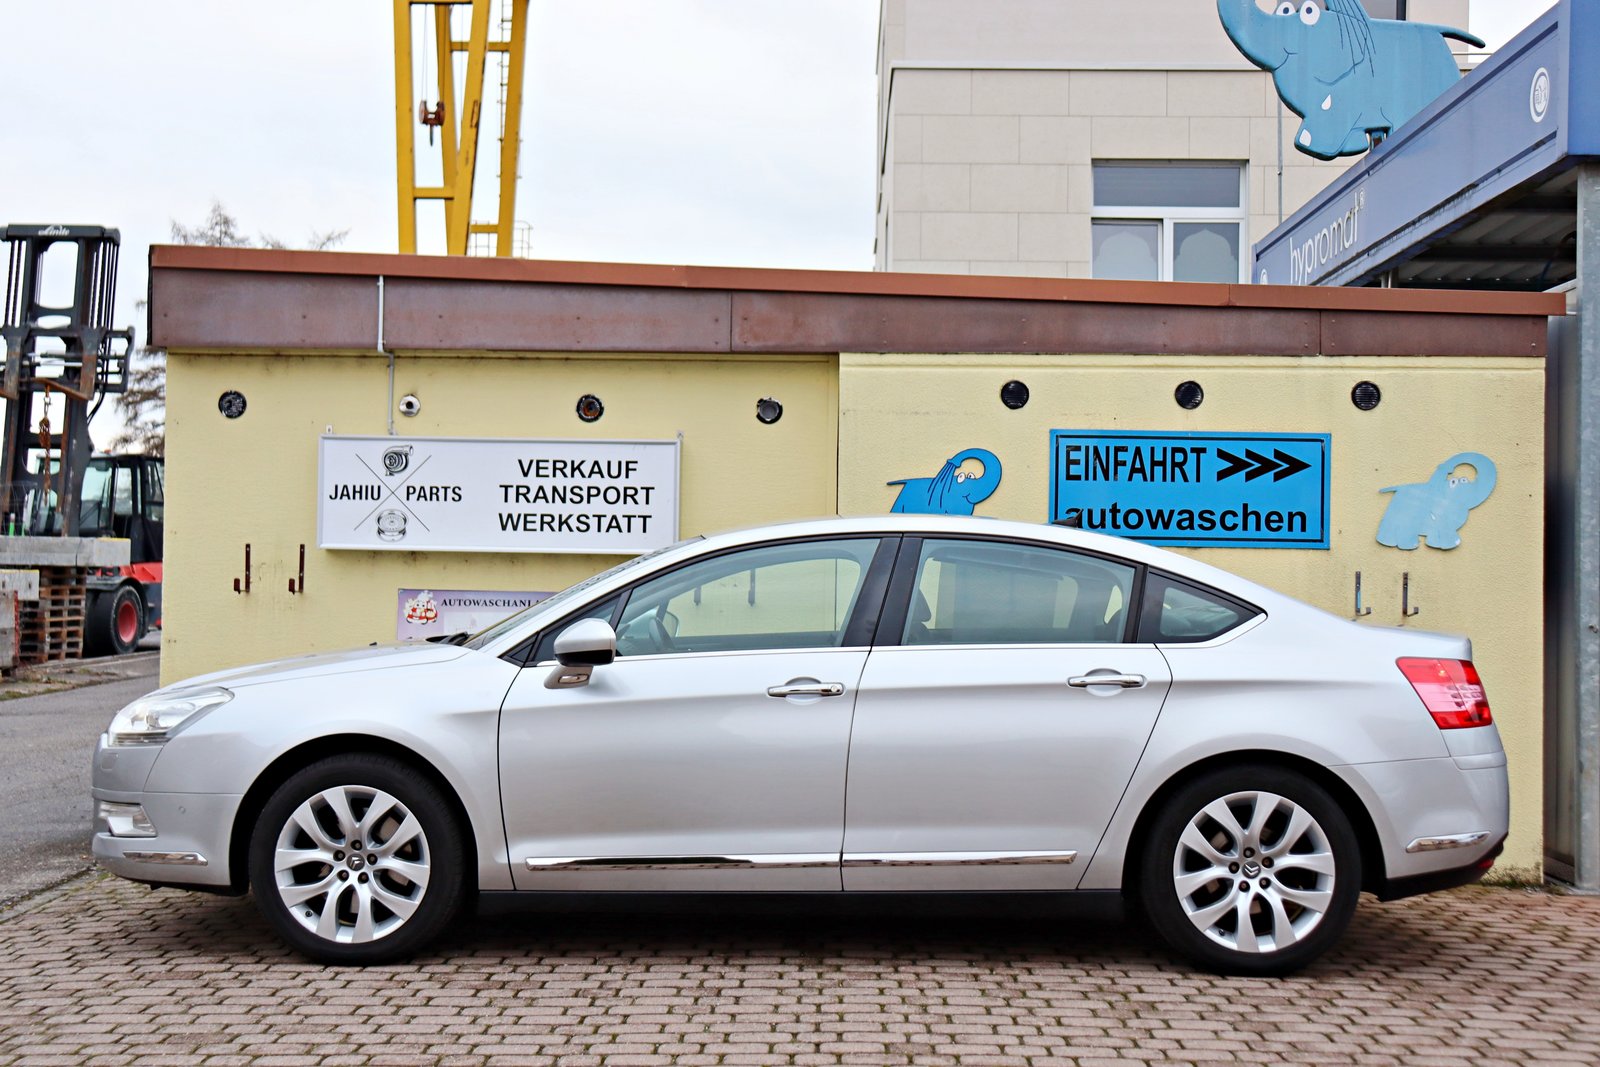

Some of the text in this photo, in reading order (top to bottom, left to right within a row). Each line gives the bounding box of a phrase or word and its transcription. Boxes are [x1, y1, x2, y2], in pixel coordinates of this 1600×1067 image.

[517, 459, 638, 479] VERKAUF
[1065, 445, 1207, 482] EINFAHRT
[329, 484, 462, 502] JAHIU PARTS
[499, 485, 655, 505] TRANSPORT
[498, 513, 652, 533] WERKSTATT
[1065, 502, 1308, 533] autowaschen
